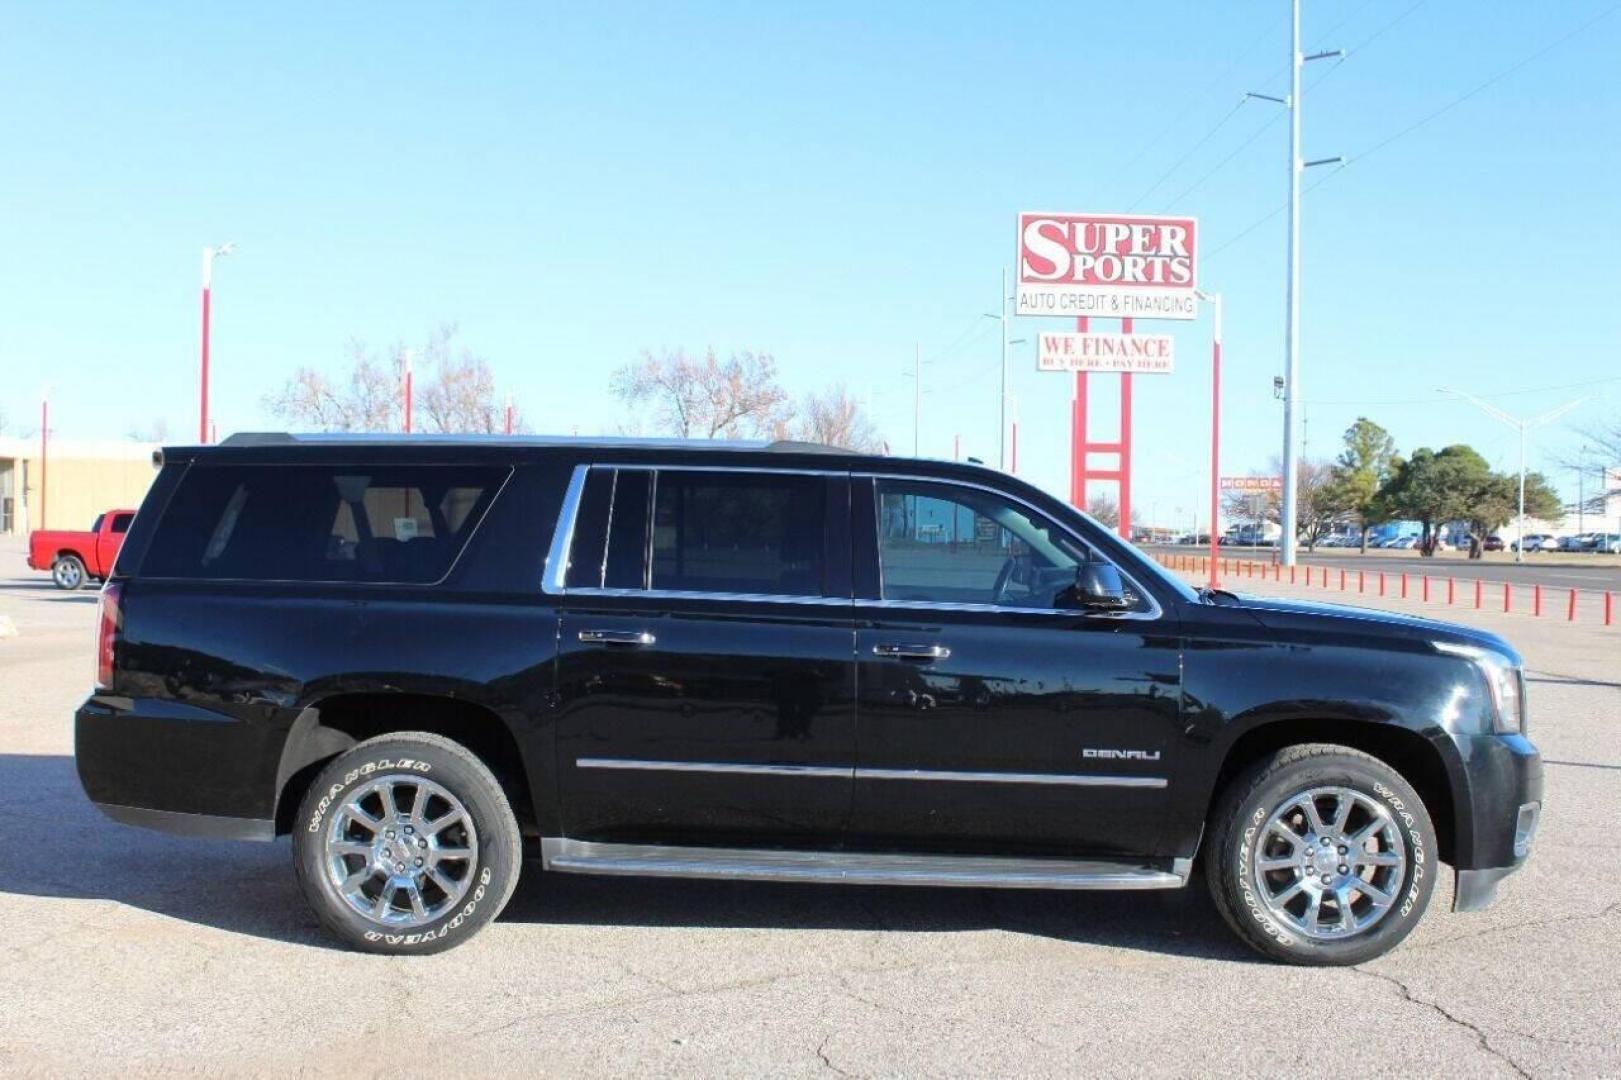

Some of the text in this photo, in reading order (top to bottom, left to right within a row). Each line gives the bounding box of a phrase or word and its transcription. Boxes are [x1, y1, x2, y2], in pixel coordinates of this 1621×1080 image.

[1023, 219, 1190, 280] SUPER
[1020, 293, 1193, 313] AUTO CREDIT & FINANCING
[1044, 336, 1170, 357] WE FINANCE
[1221, 479, 1281, 489] HONDA
[1082, 748, 1161, 760] DENALI
[308, 758, 432, 833] WRANGLER
[1373, 782, 1425, 918] WRANGLER
